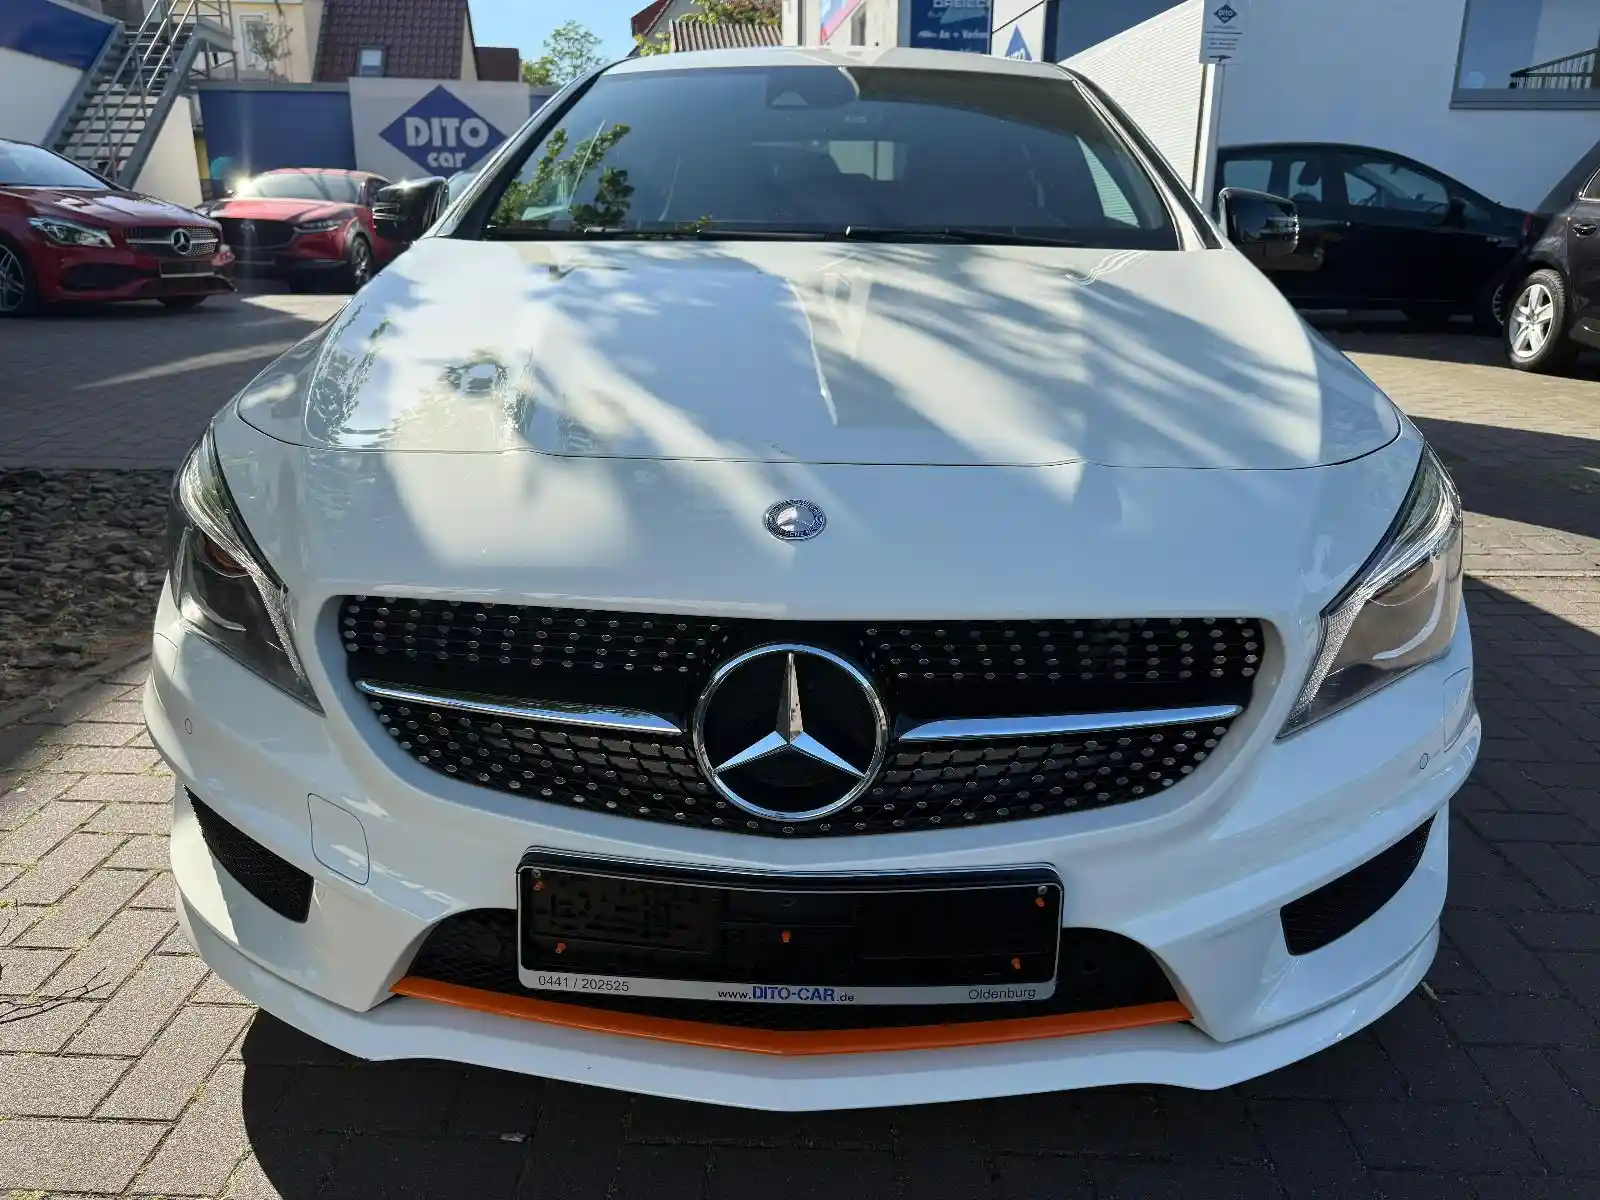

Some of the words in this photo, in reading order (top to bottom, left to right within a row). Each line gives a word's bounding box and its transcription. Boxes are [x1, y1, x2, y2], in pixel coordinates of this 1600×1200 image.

[404, 117, 490, 148] DITO
[427, 152, 466, 168] car
[538, 975, 568, 988] 0441
[573, 977, 578, 989] /
[581, 978, 629, 992] 202525
[717, 985, 855, 1002] www.DITO-CAR.de
[968, 987, 1036, 1000] Oldenburg
